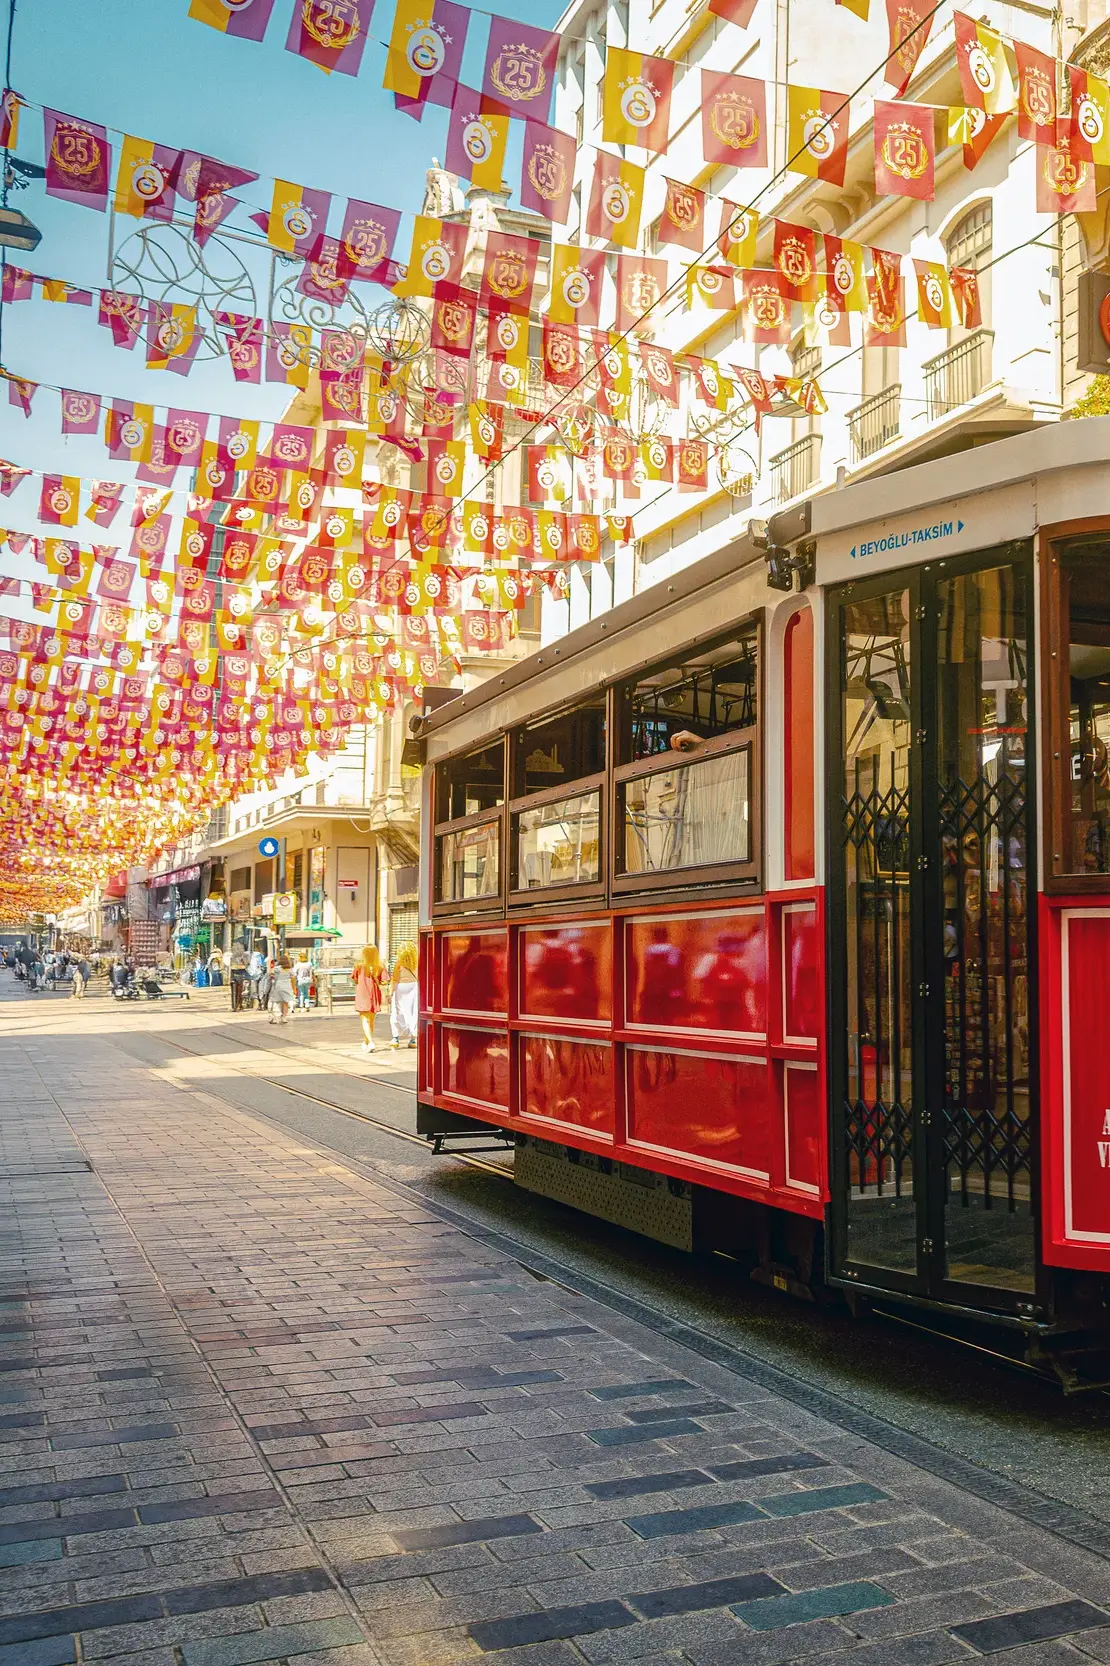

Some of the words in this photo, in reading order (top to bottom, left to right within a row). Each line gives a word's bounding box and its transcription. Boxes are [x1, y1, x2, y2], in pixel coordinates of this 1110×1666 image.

[316, 1, 346, 35] 25
[505, 60, 533, 88] 25
[723, 109, 747, 135] 25
[64, 137, 88, 162] 25
[895, 138, 917, 166] 25
[1055, 154, 1076, 181] 25
[357, 232, 379, 255] 25
[498, 265, 518, 288] 25
[757, 295, 775, 317] 25
[611, 446, 625, 463] 25
[688, 452, 701, 467] 25
[860, 521, 953, 557] BEYOĞLU-TAKSİM
